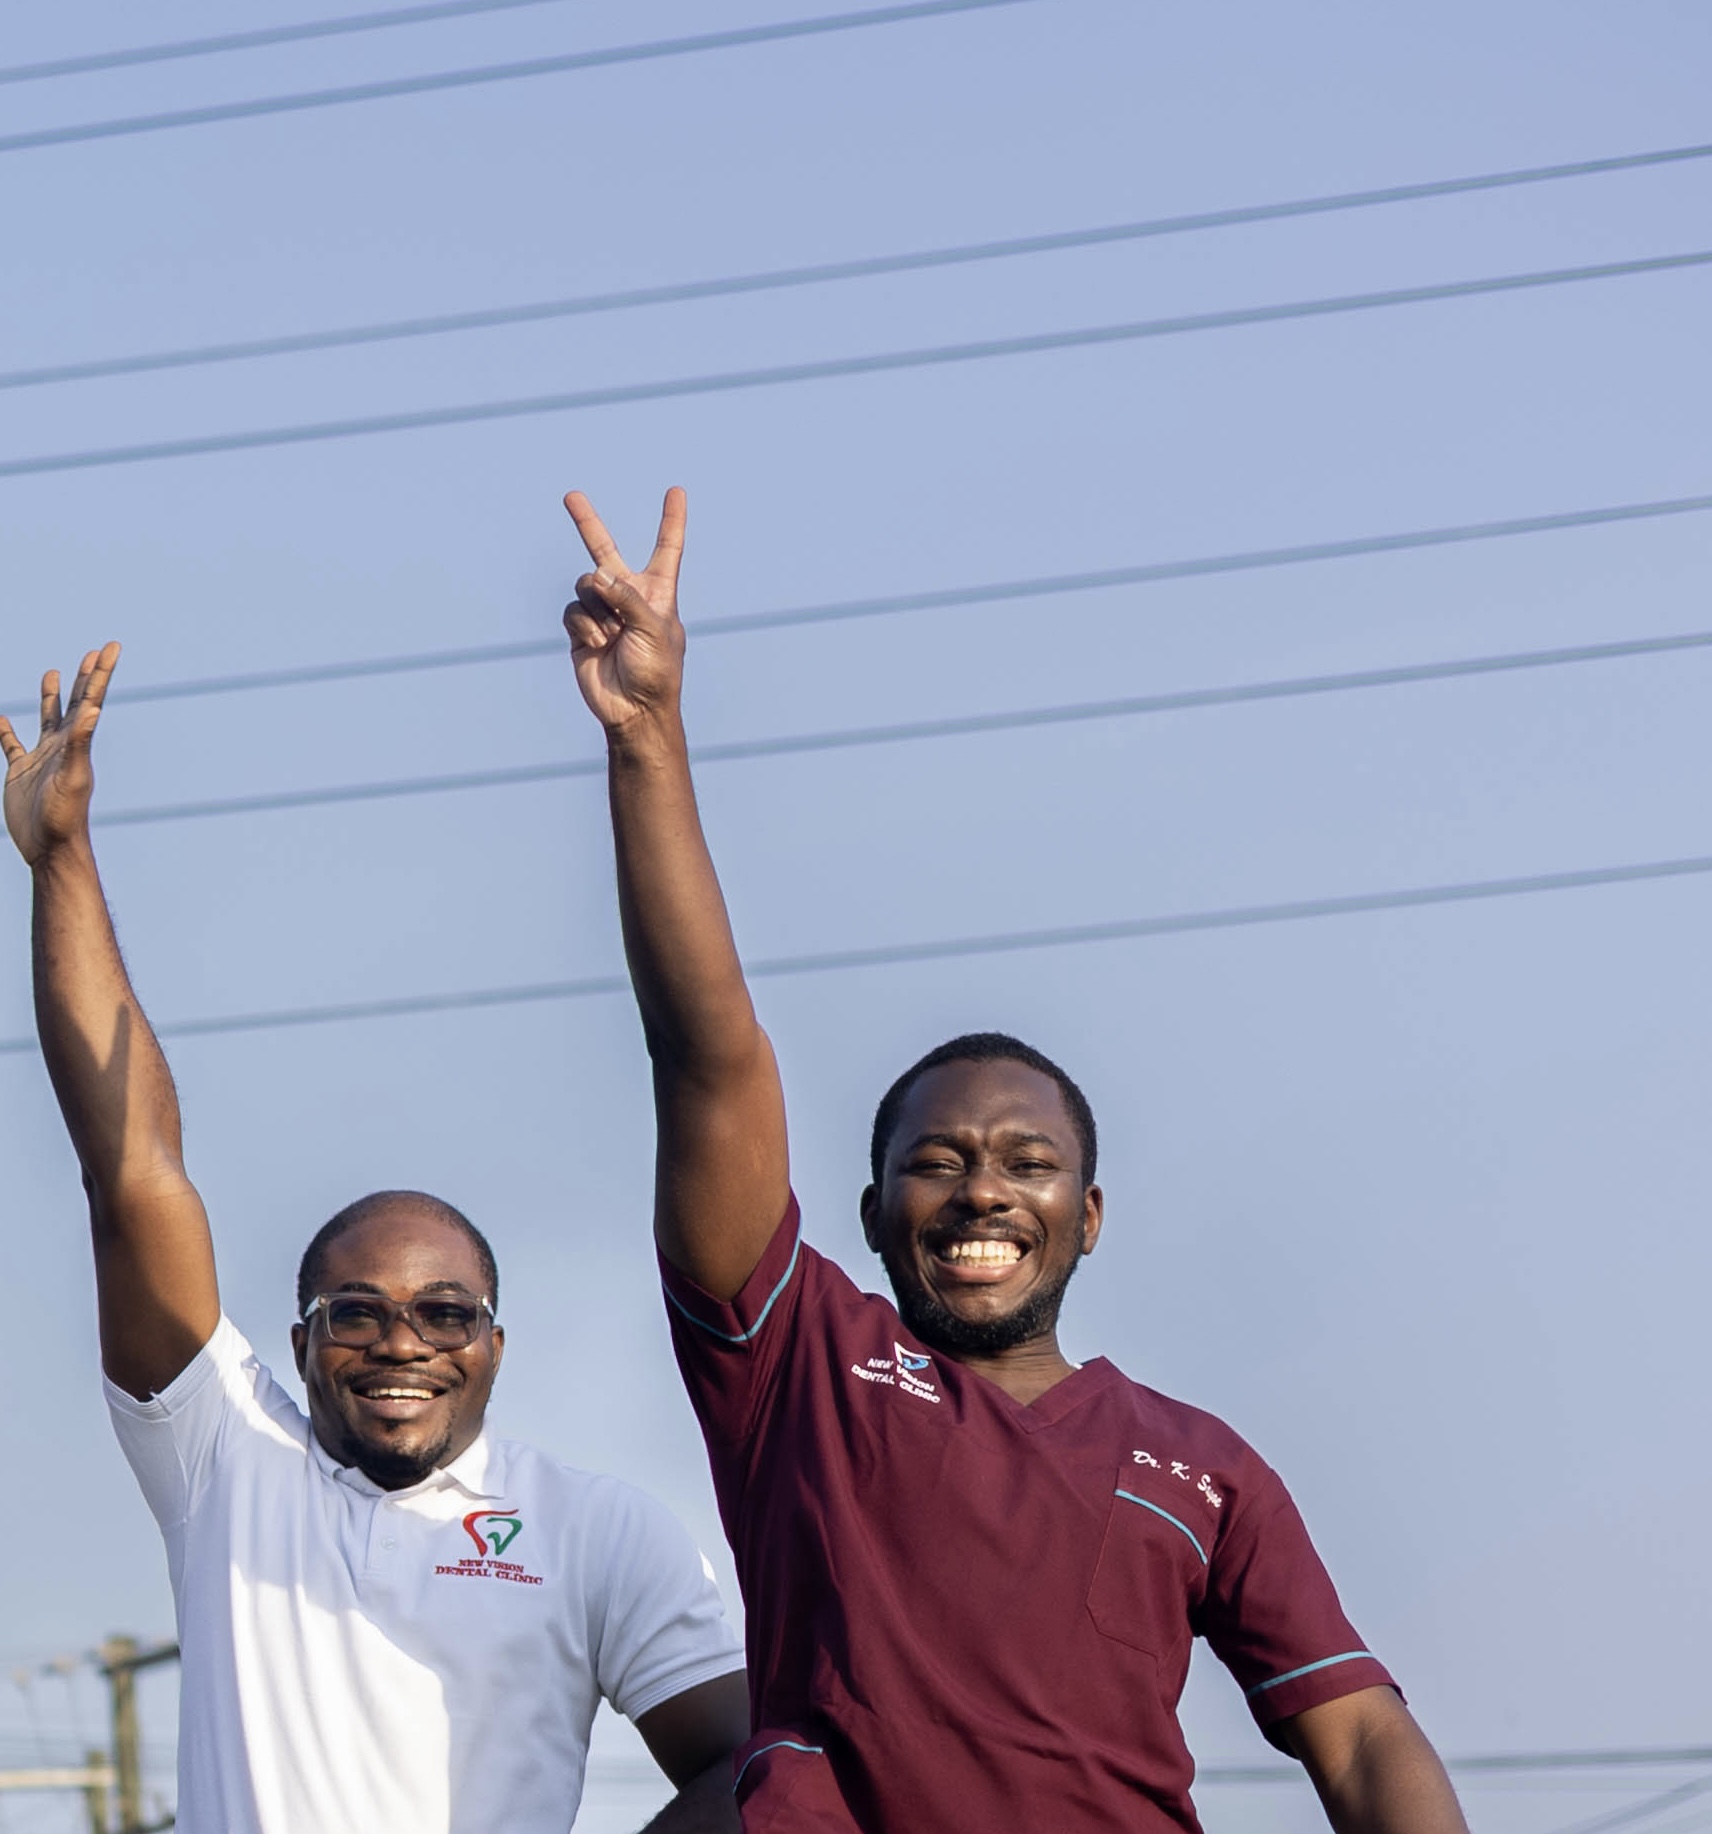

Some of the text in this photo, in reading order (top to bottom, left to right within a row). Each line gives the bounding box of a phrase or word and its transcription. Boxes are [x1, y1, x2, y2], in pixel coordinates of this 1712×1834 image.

[867, 1358, 894, 1369] NEW
[851, 1364, 895, 1385] DENTAL
[1133, 1450, 1161, 1468] Dr.
[459, 1559, 524, 1573] NEW VISION
[435, 1566, 543, 1585] DENTAL CLINIC
